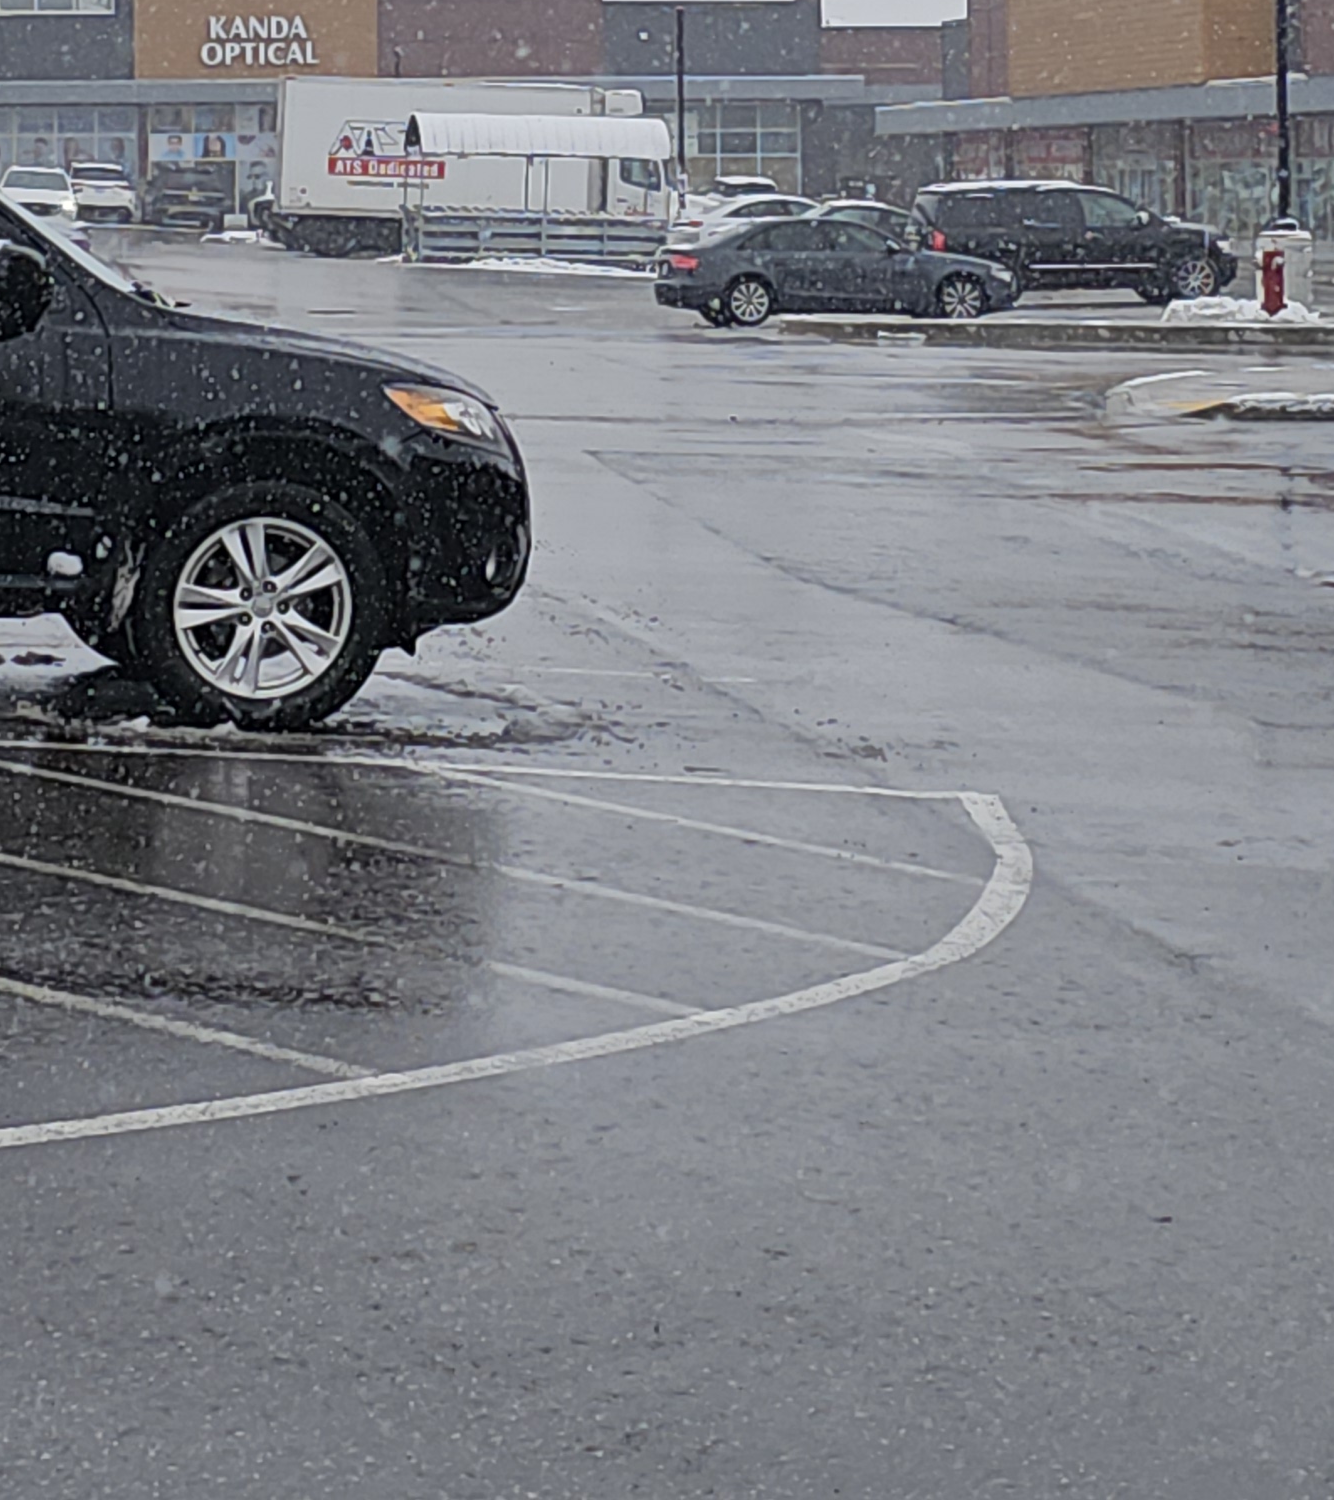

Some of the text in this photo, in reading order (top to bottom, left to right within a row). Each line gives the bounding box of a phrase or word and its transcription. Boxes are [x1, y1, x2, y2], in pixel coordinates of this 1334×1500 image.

[209, 15, 308, 39] KANDA
[200, 41, 320, 66] OPTICAL
[334, 160, 363, 174] ATS
